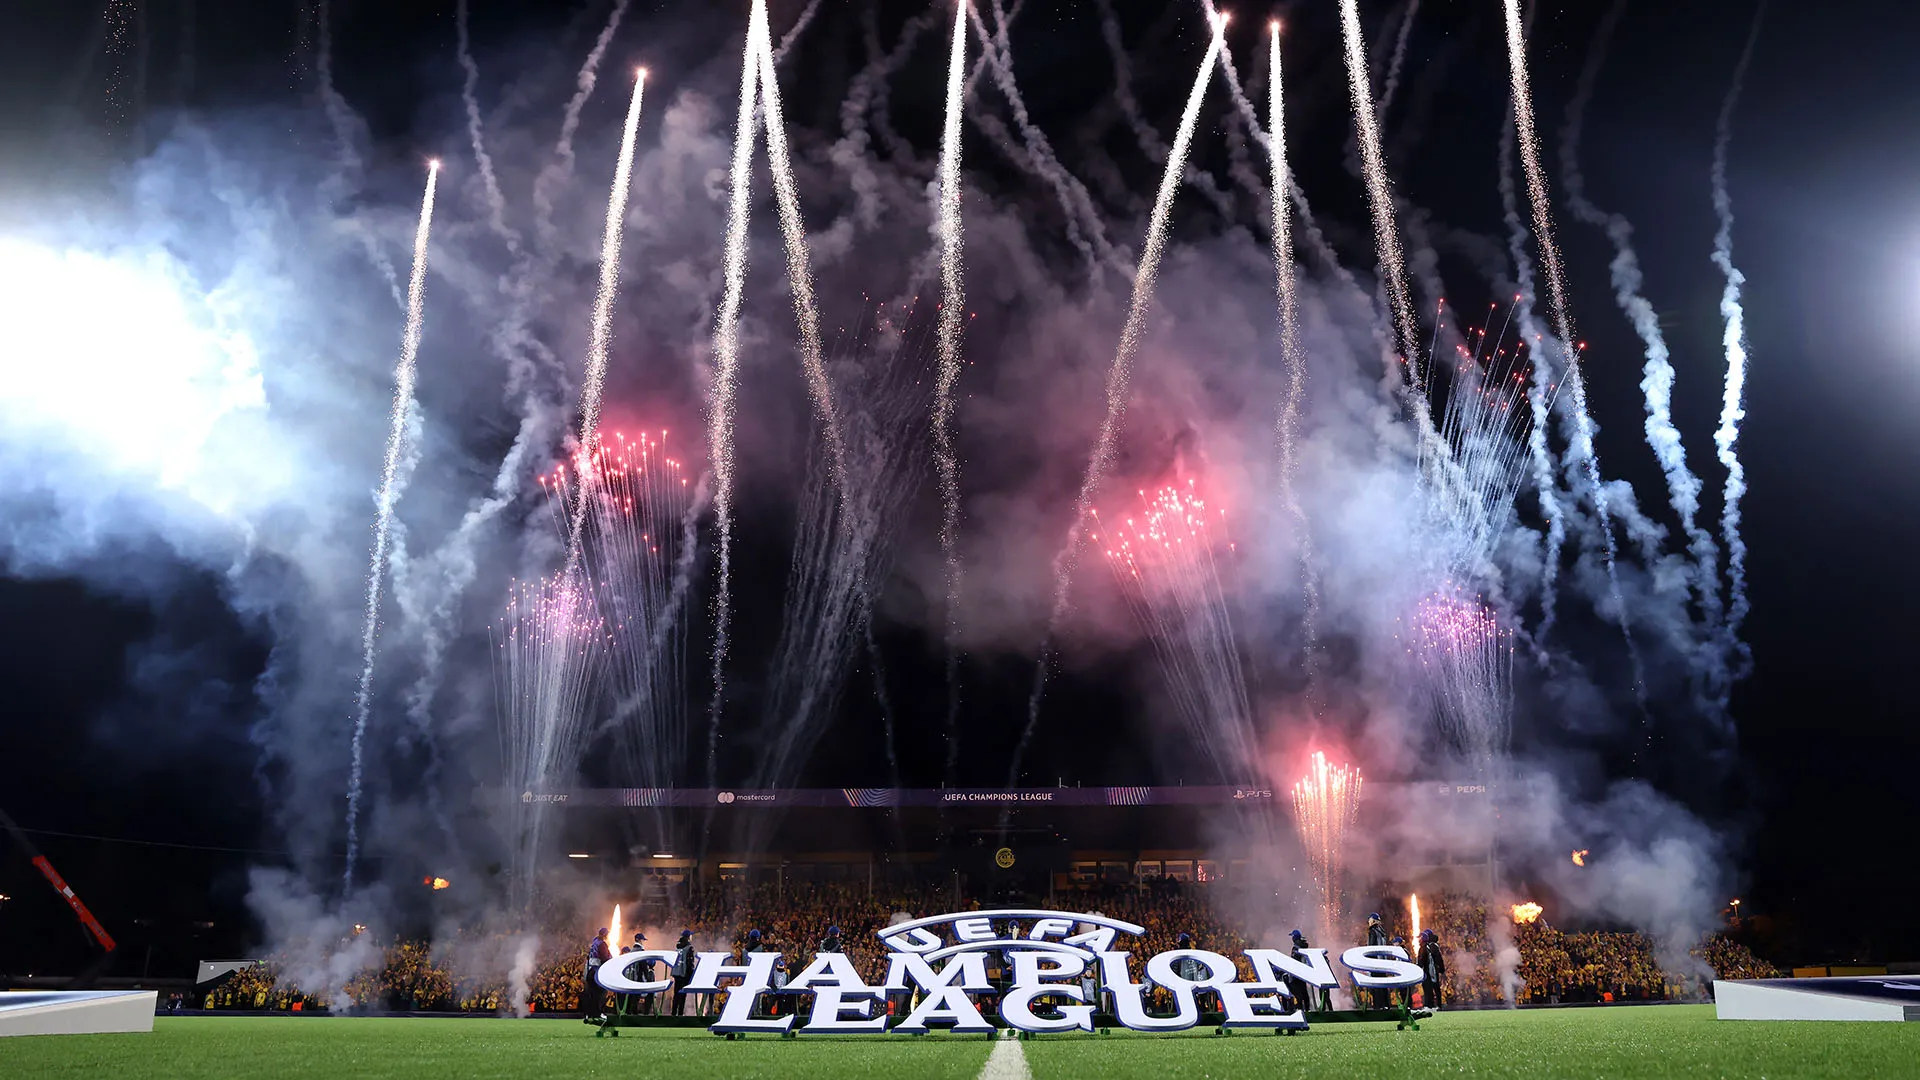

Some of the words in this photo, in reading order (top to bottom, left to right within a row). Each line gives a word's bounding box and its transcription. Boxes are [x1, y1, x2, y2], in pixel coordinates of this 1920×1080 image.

[944, 793, 967, 801] UEFA
[968, 793, 1018, 801] CHAMPIONS
[1021, 793, 1053, 801] LEAGUE
[1246, 790, 1272, 798] PS5
[1456, 785, 1486, 793] PEPSI
[884, 917, 1119, 953] UEFA
[595, 945, 1426, 995] CHAMPIONS
[709, 983, 1309, 1034] LEAGUE
